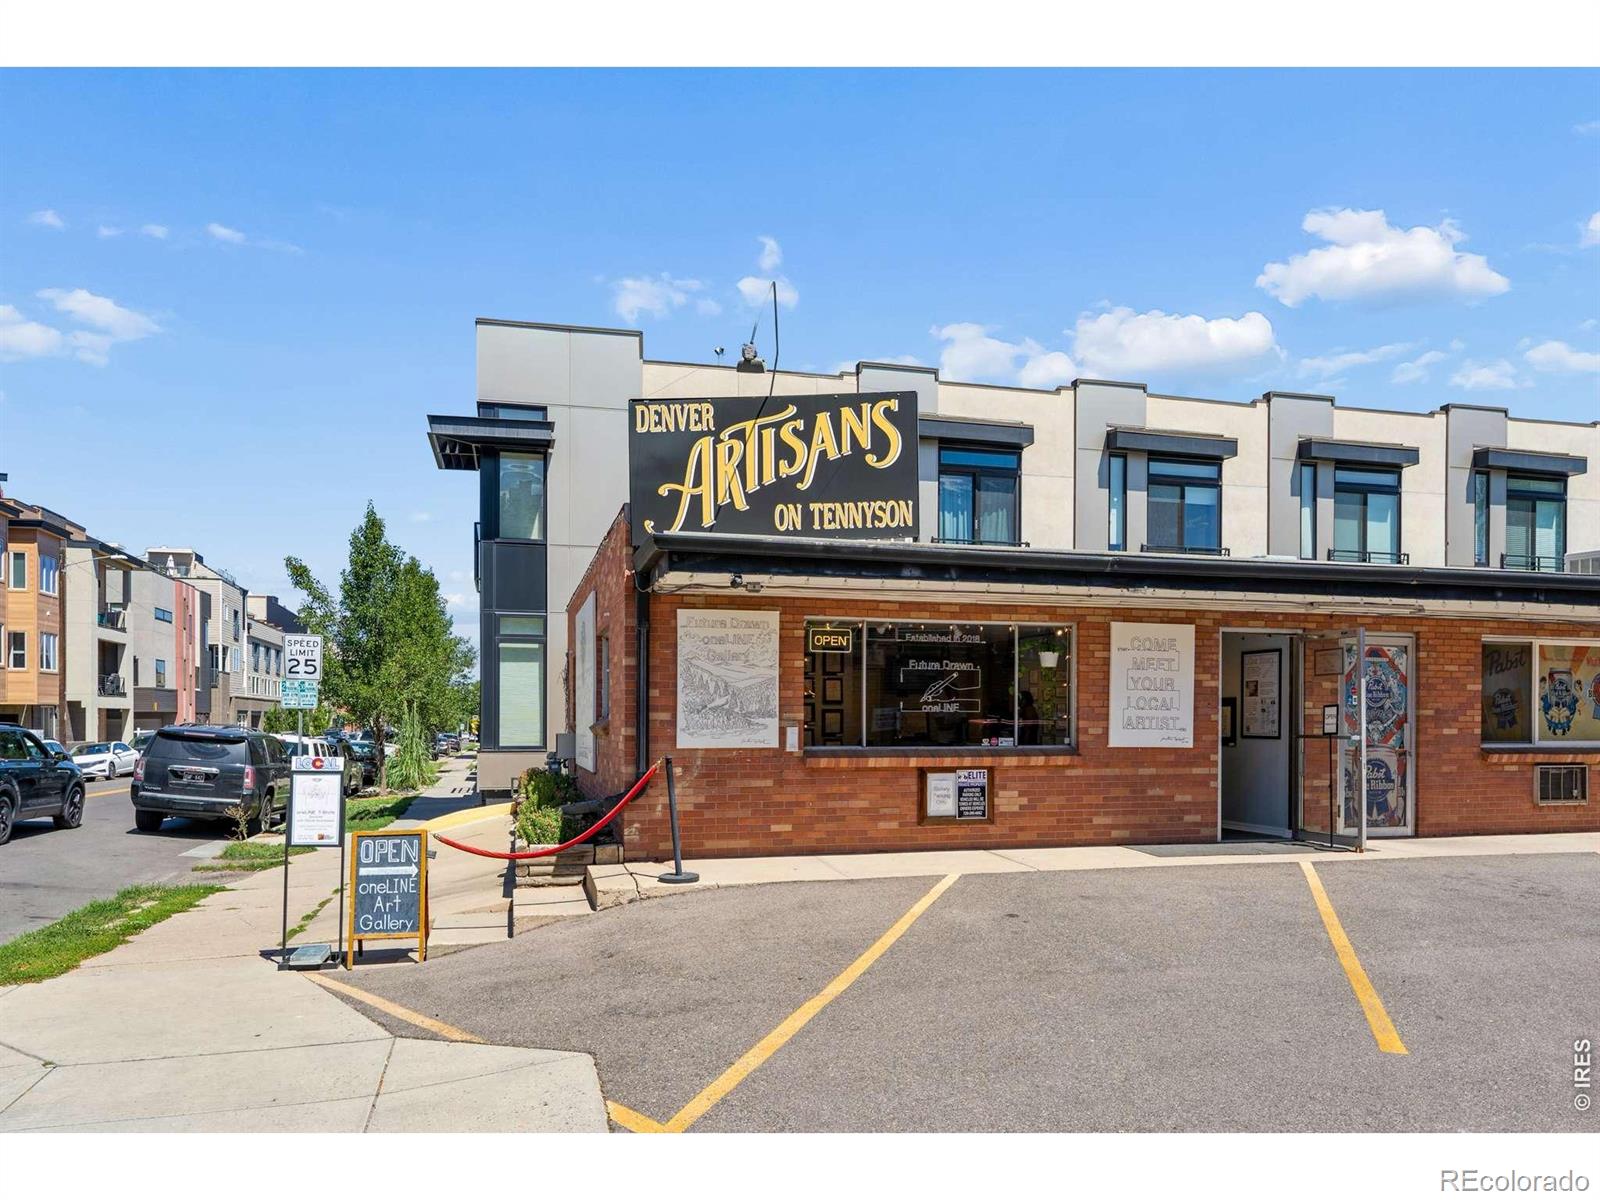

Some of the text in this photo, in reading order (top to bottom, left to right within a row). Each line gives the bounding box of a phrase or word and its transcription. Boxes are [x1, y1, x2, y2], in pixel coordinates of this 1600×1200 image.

[635, 402, 716, 434] DENVER
[644, 398, 902, 533] ARTISANS
[774, 500, 913, 531] ON TENNYSON
[686, 616, 770, 630] Future Drawn
[287, 639, 319, 648] SPEED
[701, 633, 757, 646] oneLINE
[814, 635, 848, 646] OPEN
[905, 633, 952, 643] Established
[1130, 637, 1178, 651] COME
[289, 649, 316, 657] LIMIT
[287, 658, 318, 675] 25
[908, 659, 974, 671] Future Drawn
[1131, 656, 1176, 670] MEET
[1485, 650, 1527, 677] Pabst
[1130, 676, 1175, 690] YOUR
[921, 702, 960, 712] oneLINE
[1126, 695, 1180, 710] LOCAL
[1123, 715, 1180, 730] ARTIST
[296, 757, 340, 770] LOCAL
[968, 771, 986, 780] ELITE
[1370, 780, 1394, 790] Ribbon
[360, 839, 419, 863] OPEN
[358, 878, 418, 894] oneLINE
[373, 895, 402, 912] Art
[360, 914, 413, 932] Gallery
